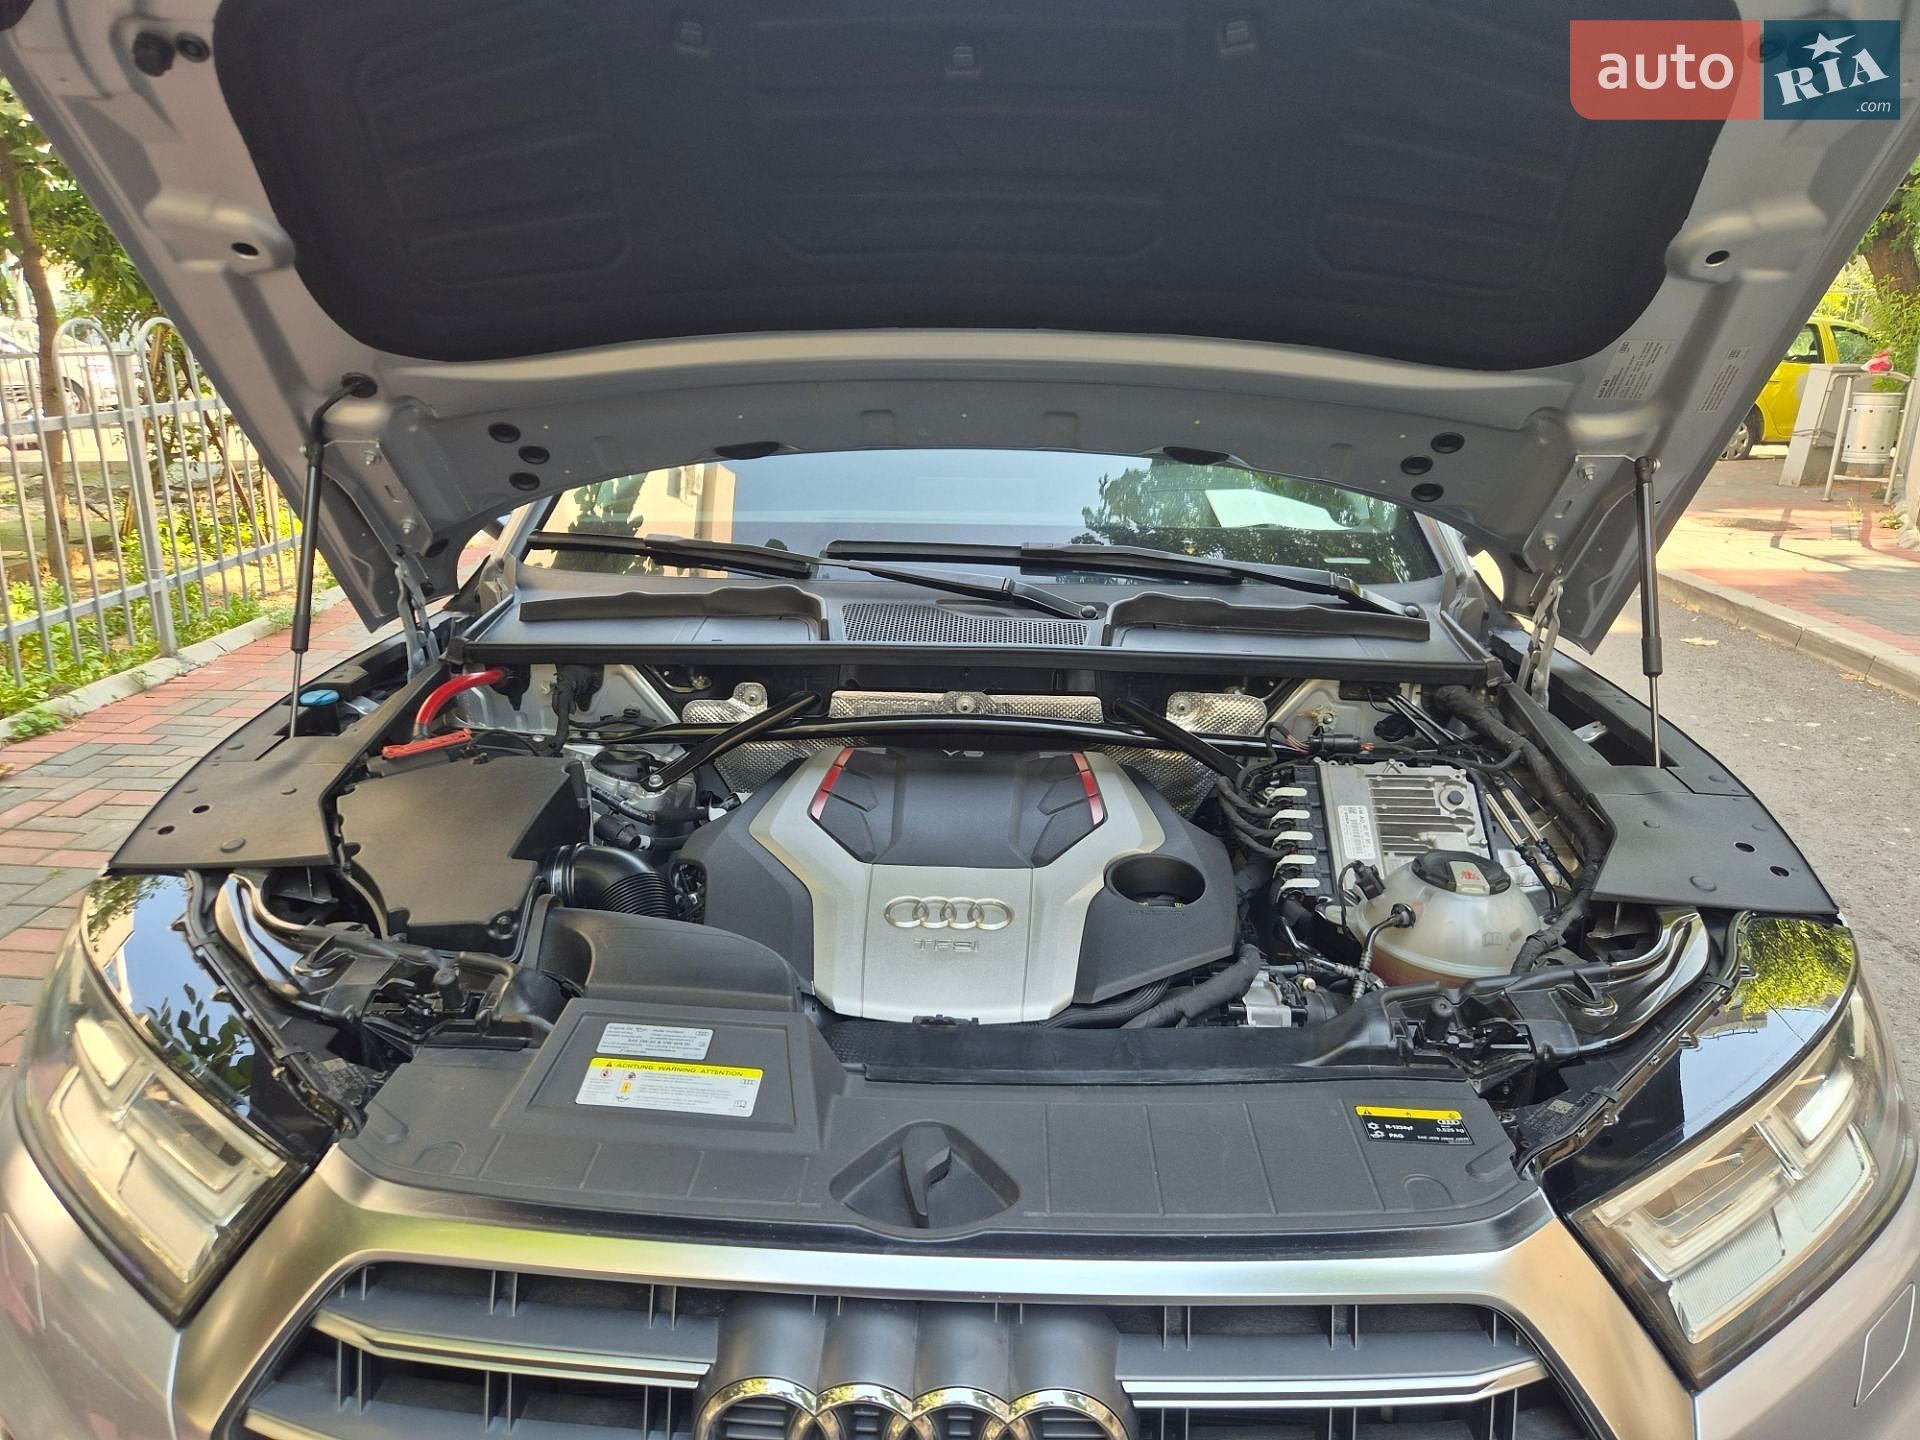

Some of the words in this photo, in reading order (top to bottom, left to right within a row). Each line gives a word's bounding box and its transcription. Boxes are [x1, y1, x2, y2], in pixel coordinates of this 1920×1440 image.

[914, 939, 981, 953] TFSI
[616, 1062, 654, 1071] ACHTUNG
[657, 1066, 697, 1074] WARNING
[700, 1069, 745, 1077] ATTENTION
